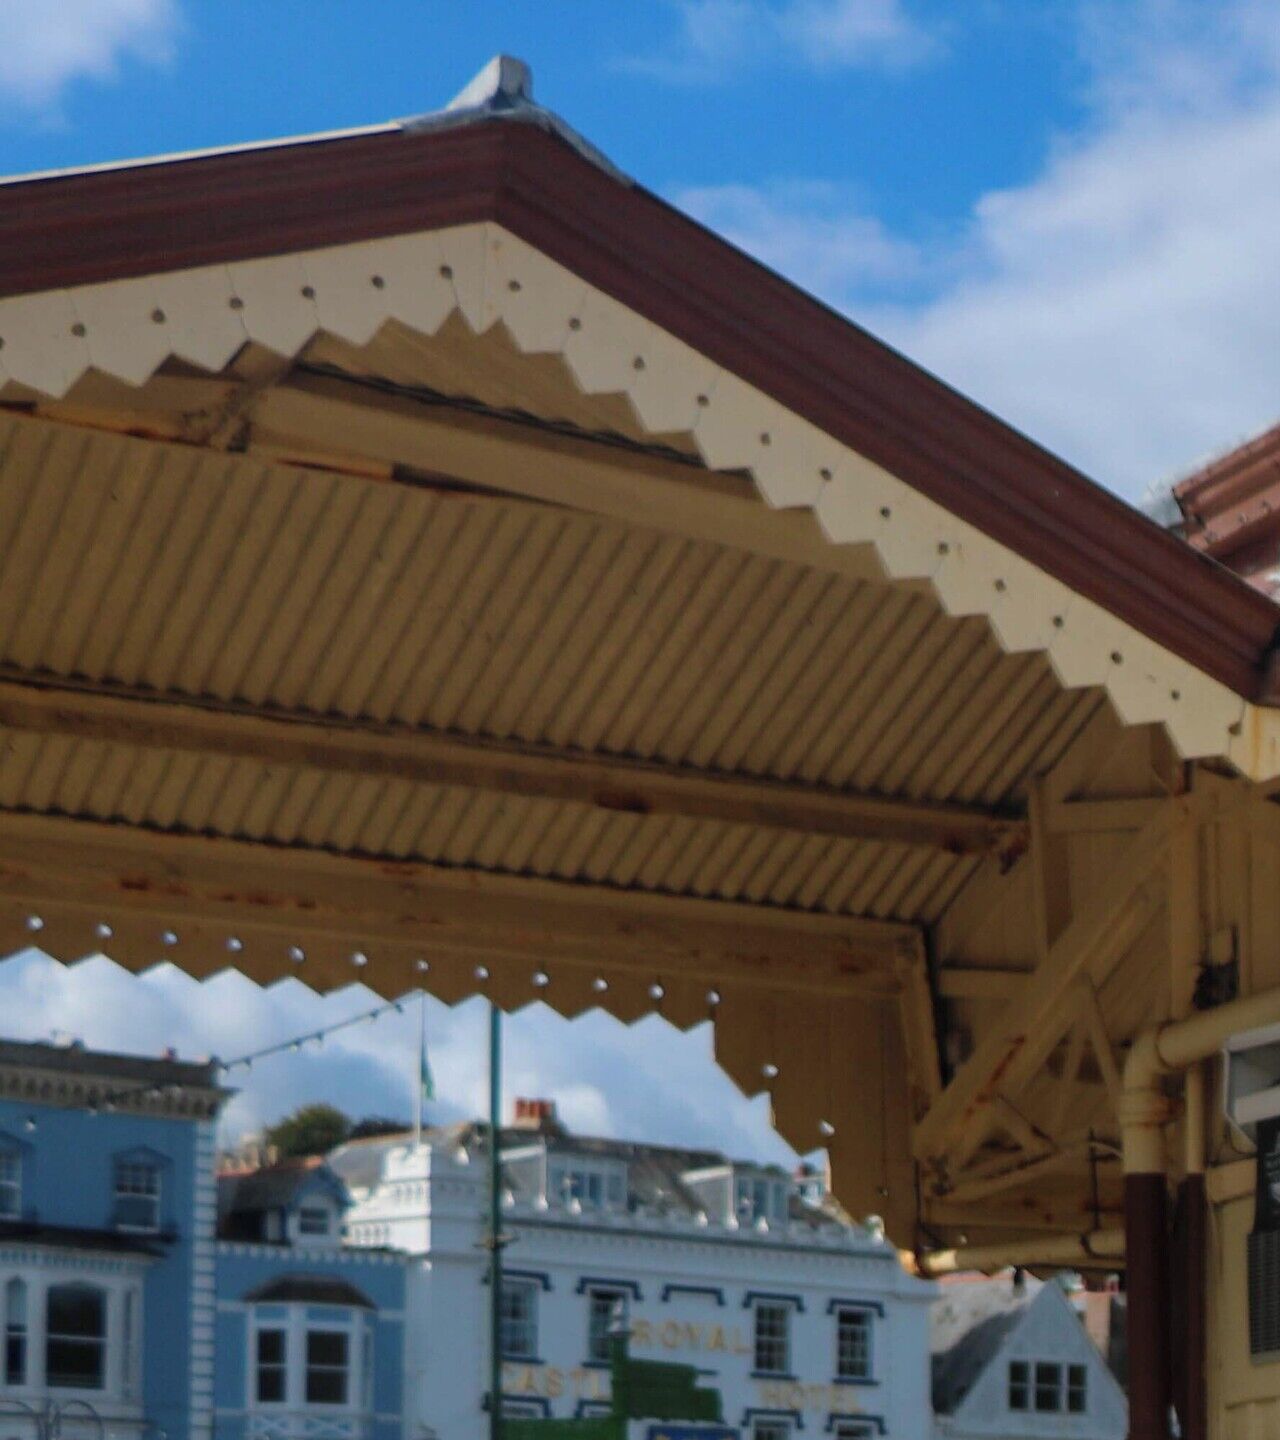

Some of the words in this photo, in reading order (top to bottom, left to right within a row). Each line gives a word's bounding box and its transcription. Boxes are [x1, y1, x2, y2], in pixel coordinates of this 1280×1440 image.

[630, 1318, 750, 1357] ROYAL
[502, 1363, 612, 1400] CASTL
[760, 1382, 863, 1413] HOTEL
